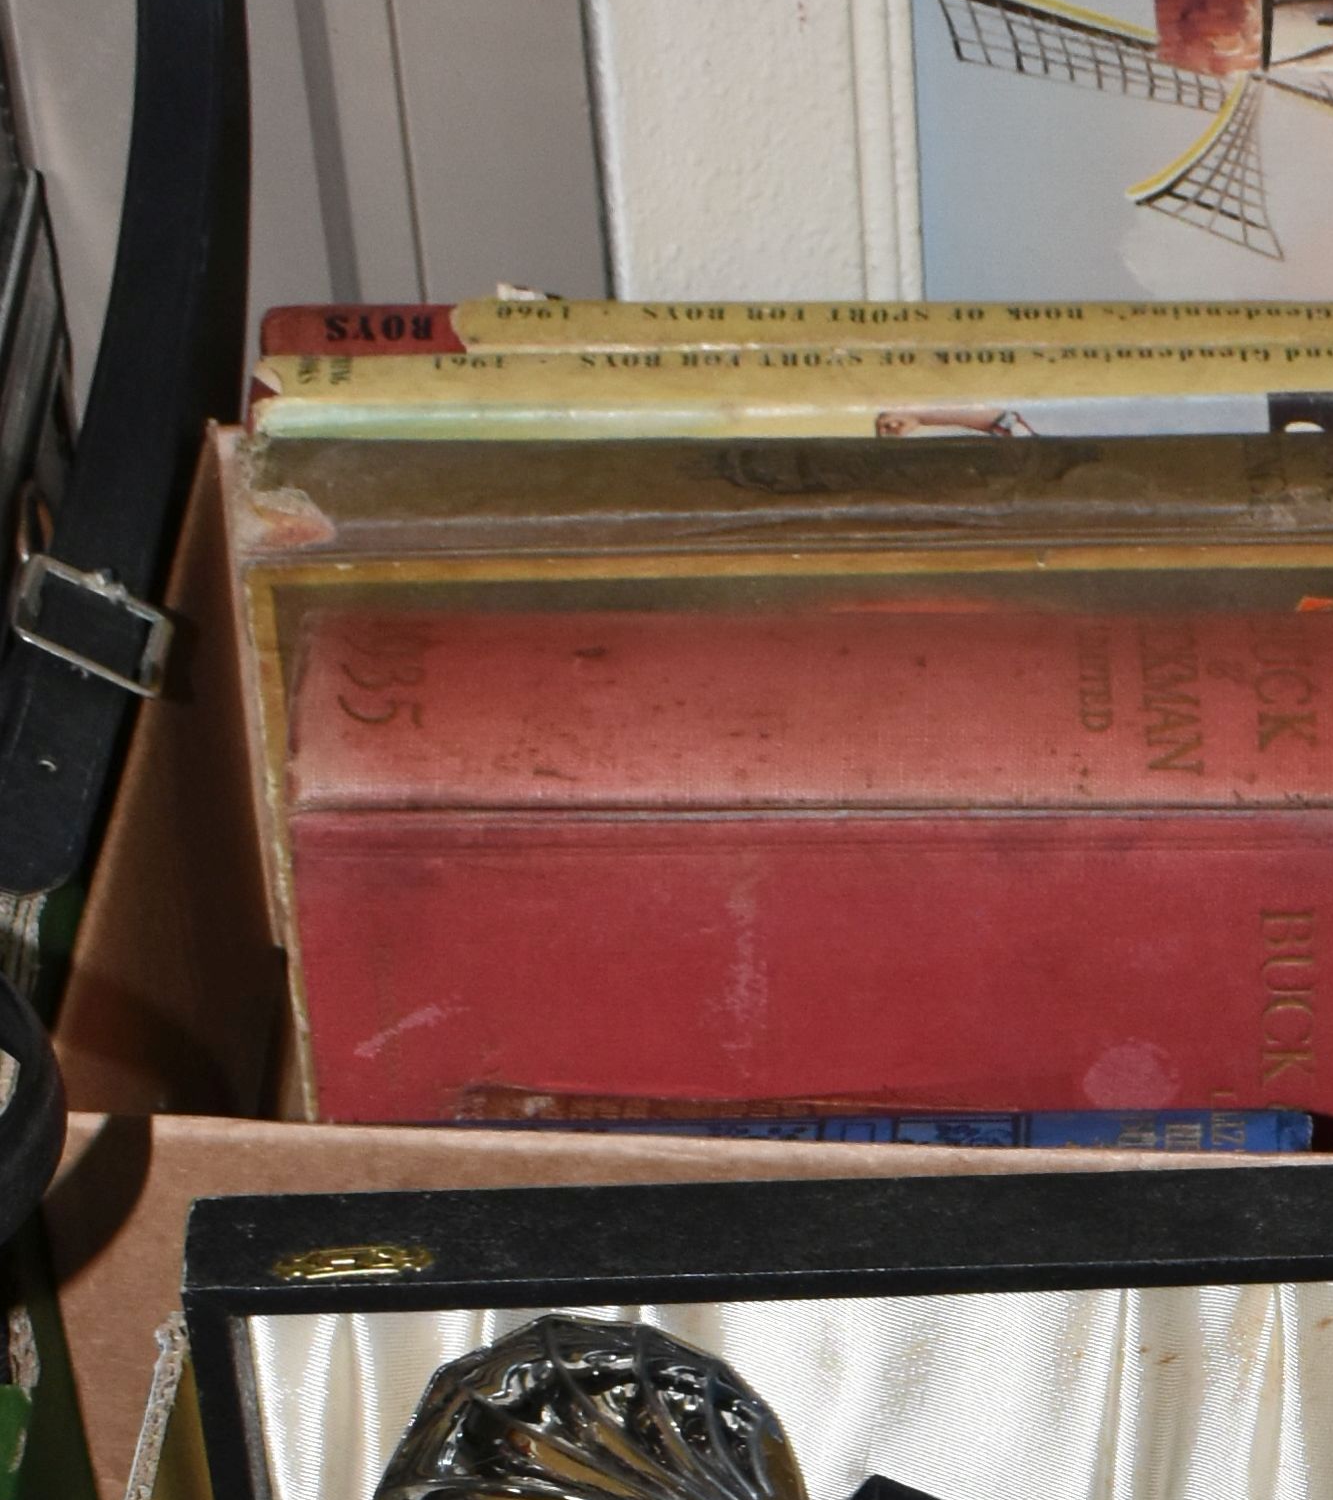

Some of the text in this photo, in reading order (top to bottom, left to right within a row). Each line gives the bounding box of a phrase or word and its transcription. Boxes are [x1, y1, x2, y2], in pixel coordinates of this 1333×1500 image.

[497, 305, 571, 320] 1960
[643, 305, 725, 321] BOYS
[746, 306, 806, 322] FOR
[829, 306, 928, 323] SPORT
[950, 306, 985, 321] OF
[1007, 305, 1083, 321] BOOK
[325, 315, 433, 342] BOYS
[880, 351, 915, 365] OF
[934, 349, 1015, 365] BOOK
[1259, 908, 1316, 1088] BUCK
